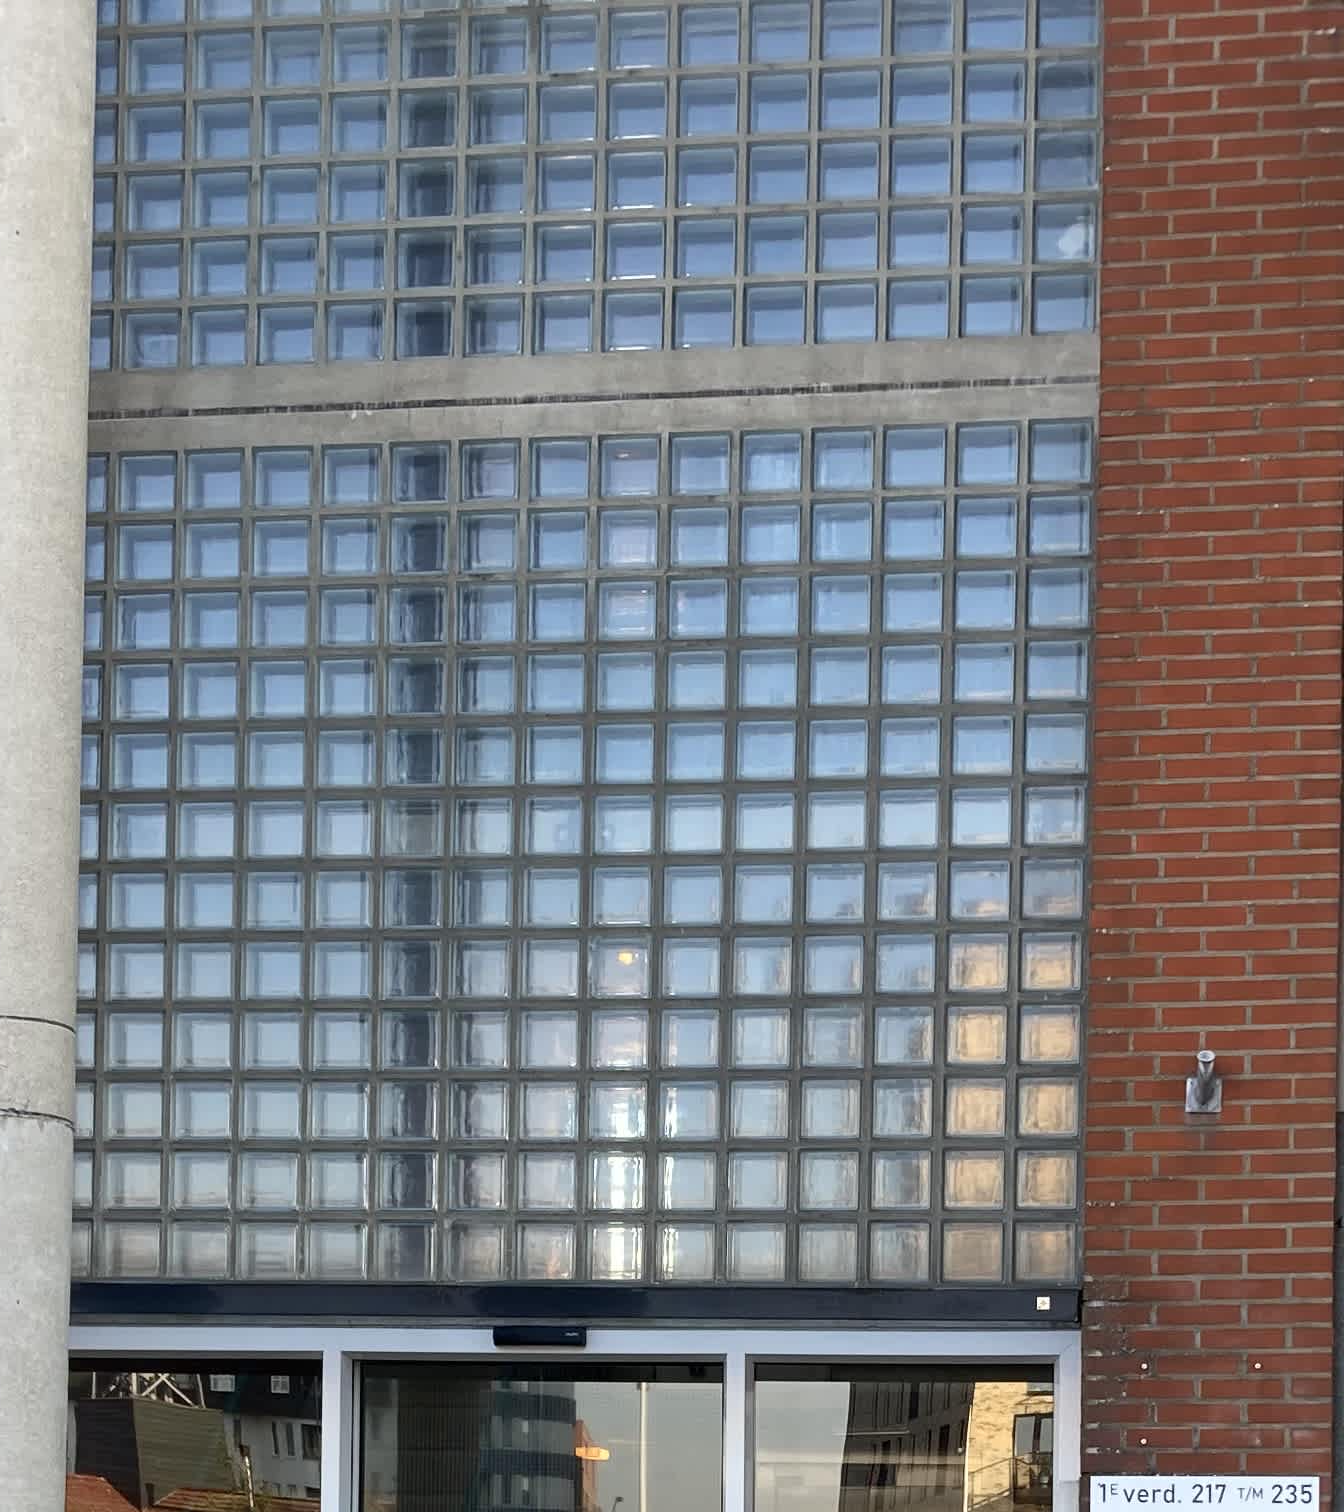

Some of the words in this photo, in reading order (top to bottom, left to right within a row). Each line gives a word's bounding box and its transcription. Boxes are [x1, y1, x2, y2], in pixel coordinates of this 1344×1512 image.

[1123, 1483, 1182, 1504] verd.
[1191, 1483, 1227, 1504] 217
[1236, 1486, 1264, 1501] T/M
[1271, 1483, 1313, 1504] 235
